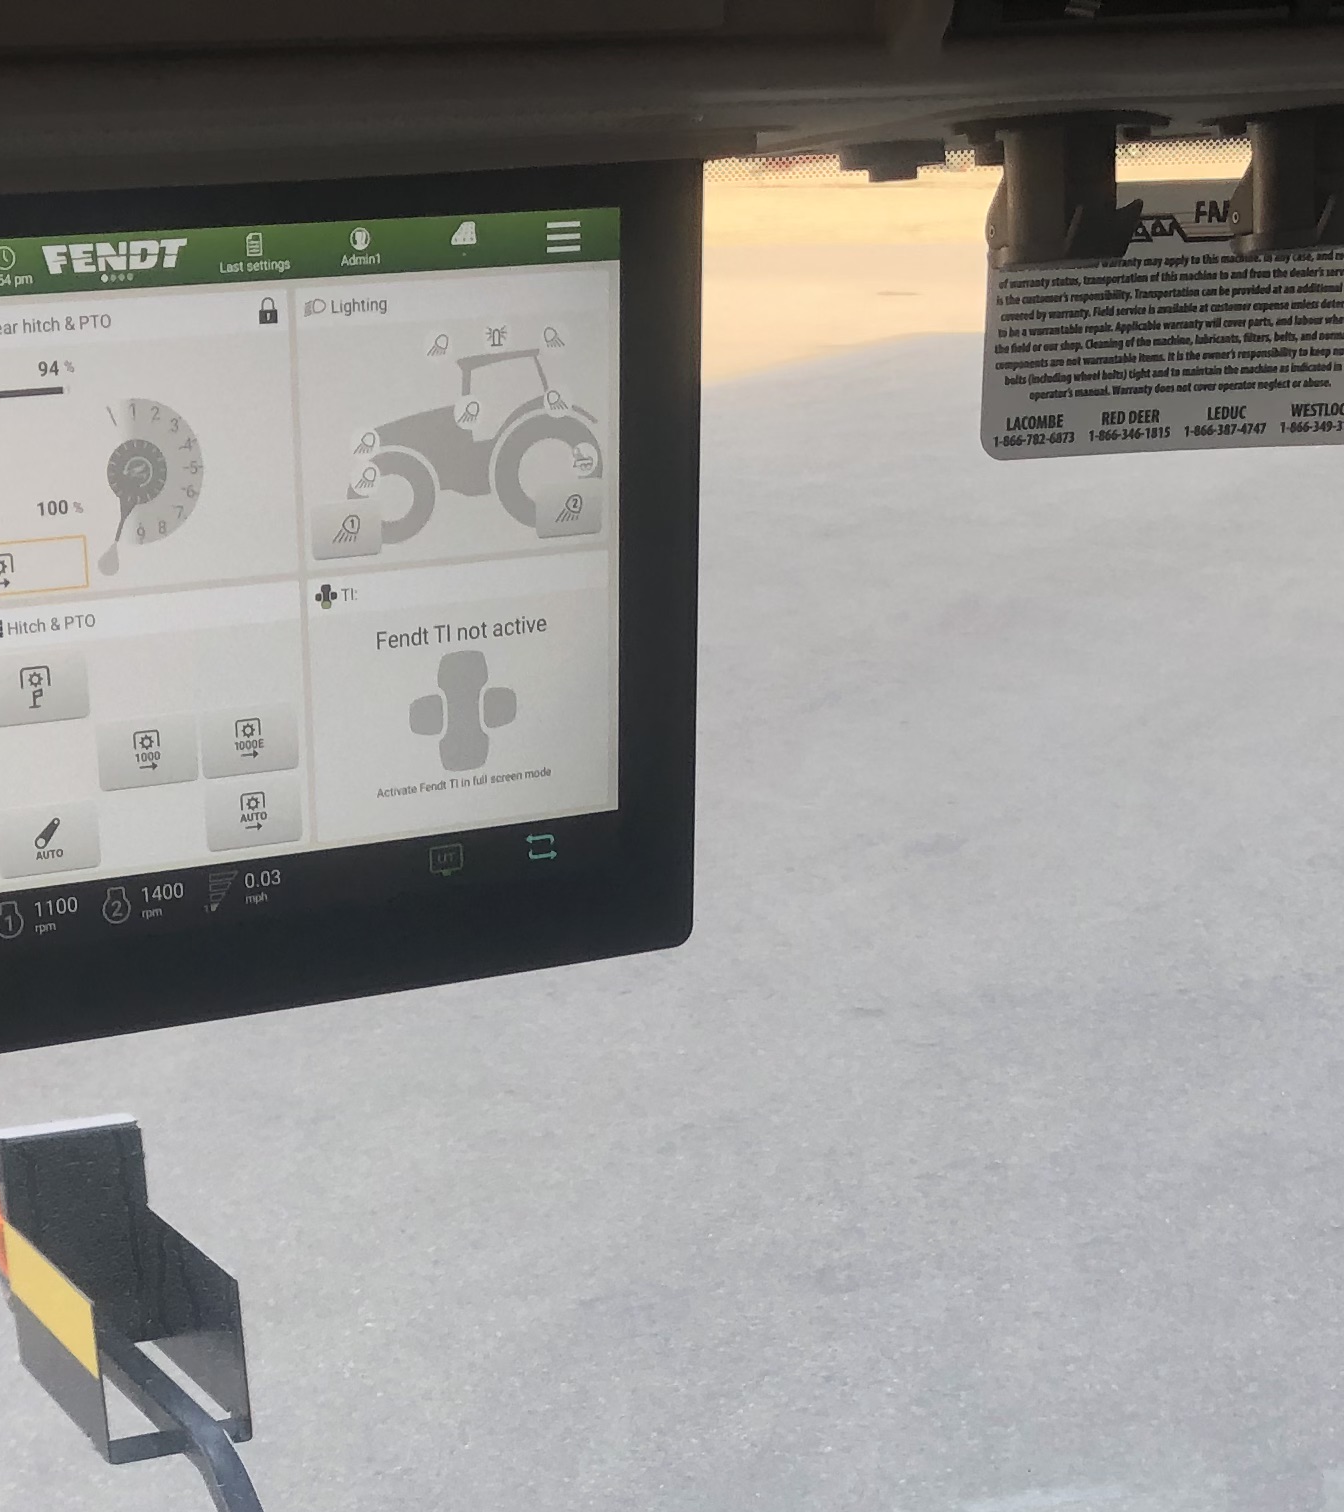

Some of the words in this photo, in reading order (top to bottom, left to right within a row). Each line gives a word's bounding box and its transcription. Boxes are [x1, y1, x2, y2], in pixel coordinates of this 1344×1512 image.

[42, 238, 187, 274] FENDT
[341, 253, 381, 267] Admin1
[219, 261, 244, 274] Last
[247, 259, 291, 274] settings
[14, 274, 33, 286] pm
[331, 299, 387, 316] Lighting
[1001, 311, 1034, 321] covered
[1037, 309, 1046, 322] by
[1049, 309, 1091, 320] warranty.
[1093, 307, 1114, 317] Field
[1116, 306, 1146, 316] service
[1157, 303, 1197, 314] available
[1199, 303, 1208, 312] at
[1211, 302, 1251, 312] customer
[1253, 302, 1289, 313] expense
[1291, 299, 1319, 309] unless
[22, 318, 60, 333] hitch
[64, 316, 76, 330] &
[79, 315, 112, 329] PTO
[38, 361, 59, 377] 94
[1030, 388, 1073, 401] operator's
[1112, 385, 1152, 396] Warranty
[1155, 383, 1174, 393] does
[1177, 383, 1191, 392] not
[1194, 382, 1216, 392] cover
[1218, 380, 1255, 392] operator
[1258, 379, 1290, 390] neglect
[1292, 379, 1301, 388] or
[1303, 377, 1331, 388] abuse.
[1102, 411, 1125, 425] RED
[1129, 409, 1160, 424] DEER
[1207, 406, 1246, 421] LEDUC
[1006, 414, 1063, 431] LACOMBE
[993, 432, 1075, 447] 1-866-782-6873
[1089, 426, 1170, 441] 1-866-346-1815
[37, 501, 68, 516] 100
[8, 619, 45, 636] Hitch
[50, 618, 60, 630] &
[65, 614, 95, 629] PTO
[376, 628, 429, 650] Fendt
[434, 625, 451, 643] TI
[457, 622, 487, 641] not
[493, 616, 547, 637] active
[234, 738, 264, 751] 1000E
[135, 751, 160, 762] 1000
[377, 784, 417, 798] Activate
[420, 780, 446, 793] Fendt
[450, 778, 459, 788] TI
[461, 777, 470, 788] in
[473, 774, 487, 786] full
[491, 771, 522, 784] screen
[525, 767, 551, 779] mode
[240, 811, 267, 823] AUTO
[36, 849, 63, 860] AUTO
[245, 869, 281, 889] 0.03
[142, 882, 184, 903] 1400
[246, 892, 267, 905] mph
[34, 897, 78, 917] 1100
[142, 906, 162, 919] rpm
[35, 921, 56, 935] rpm
